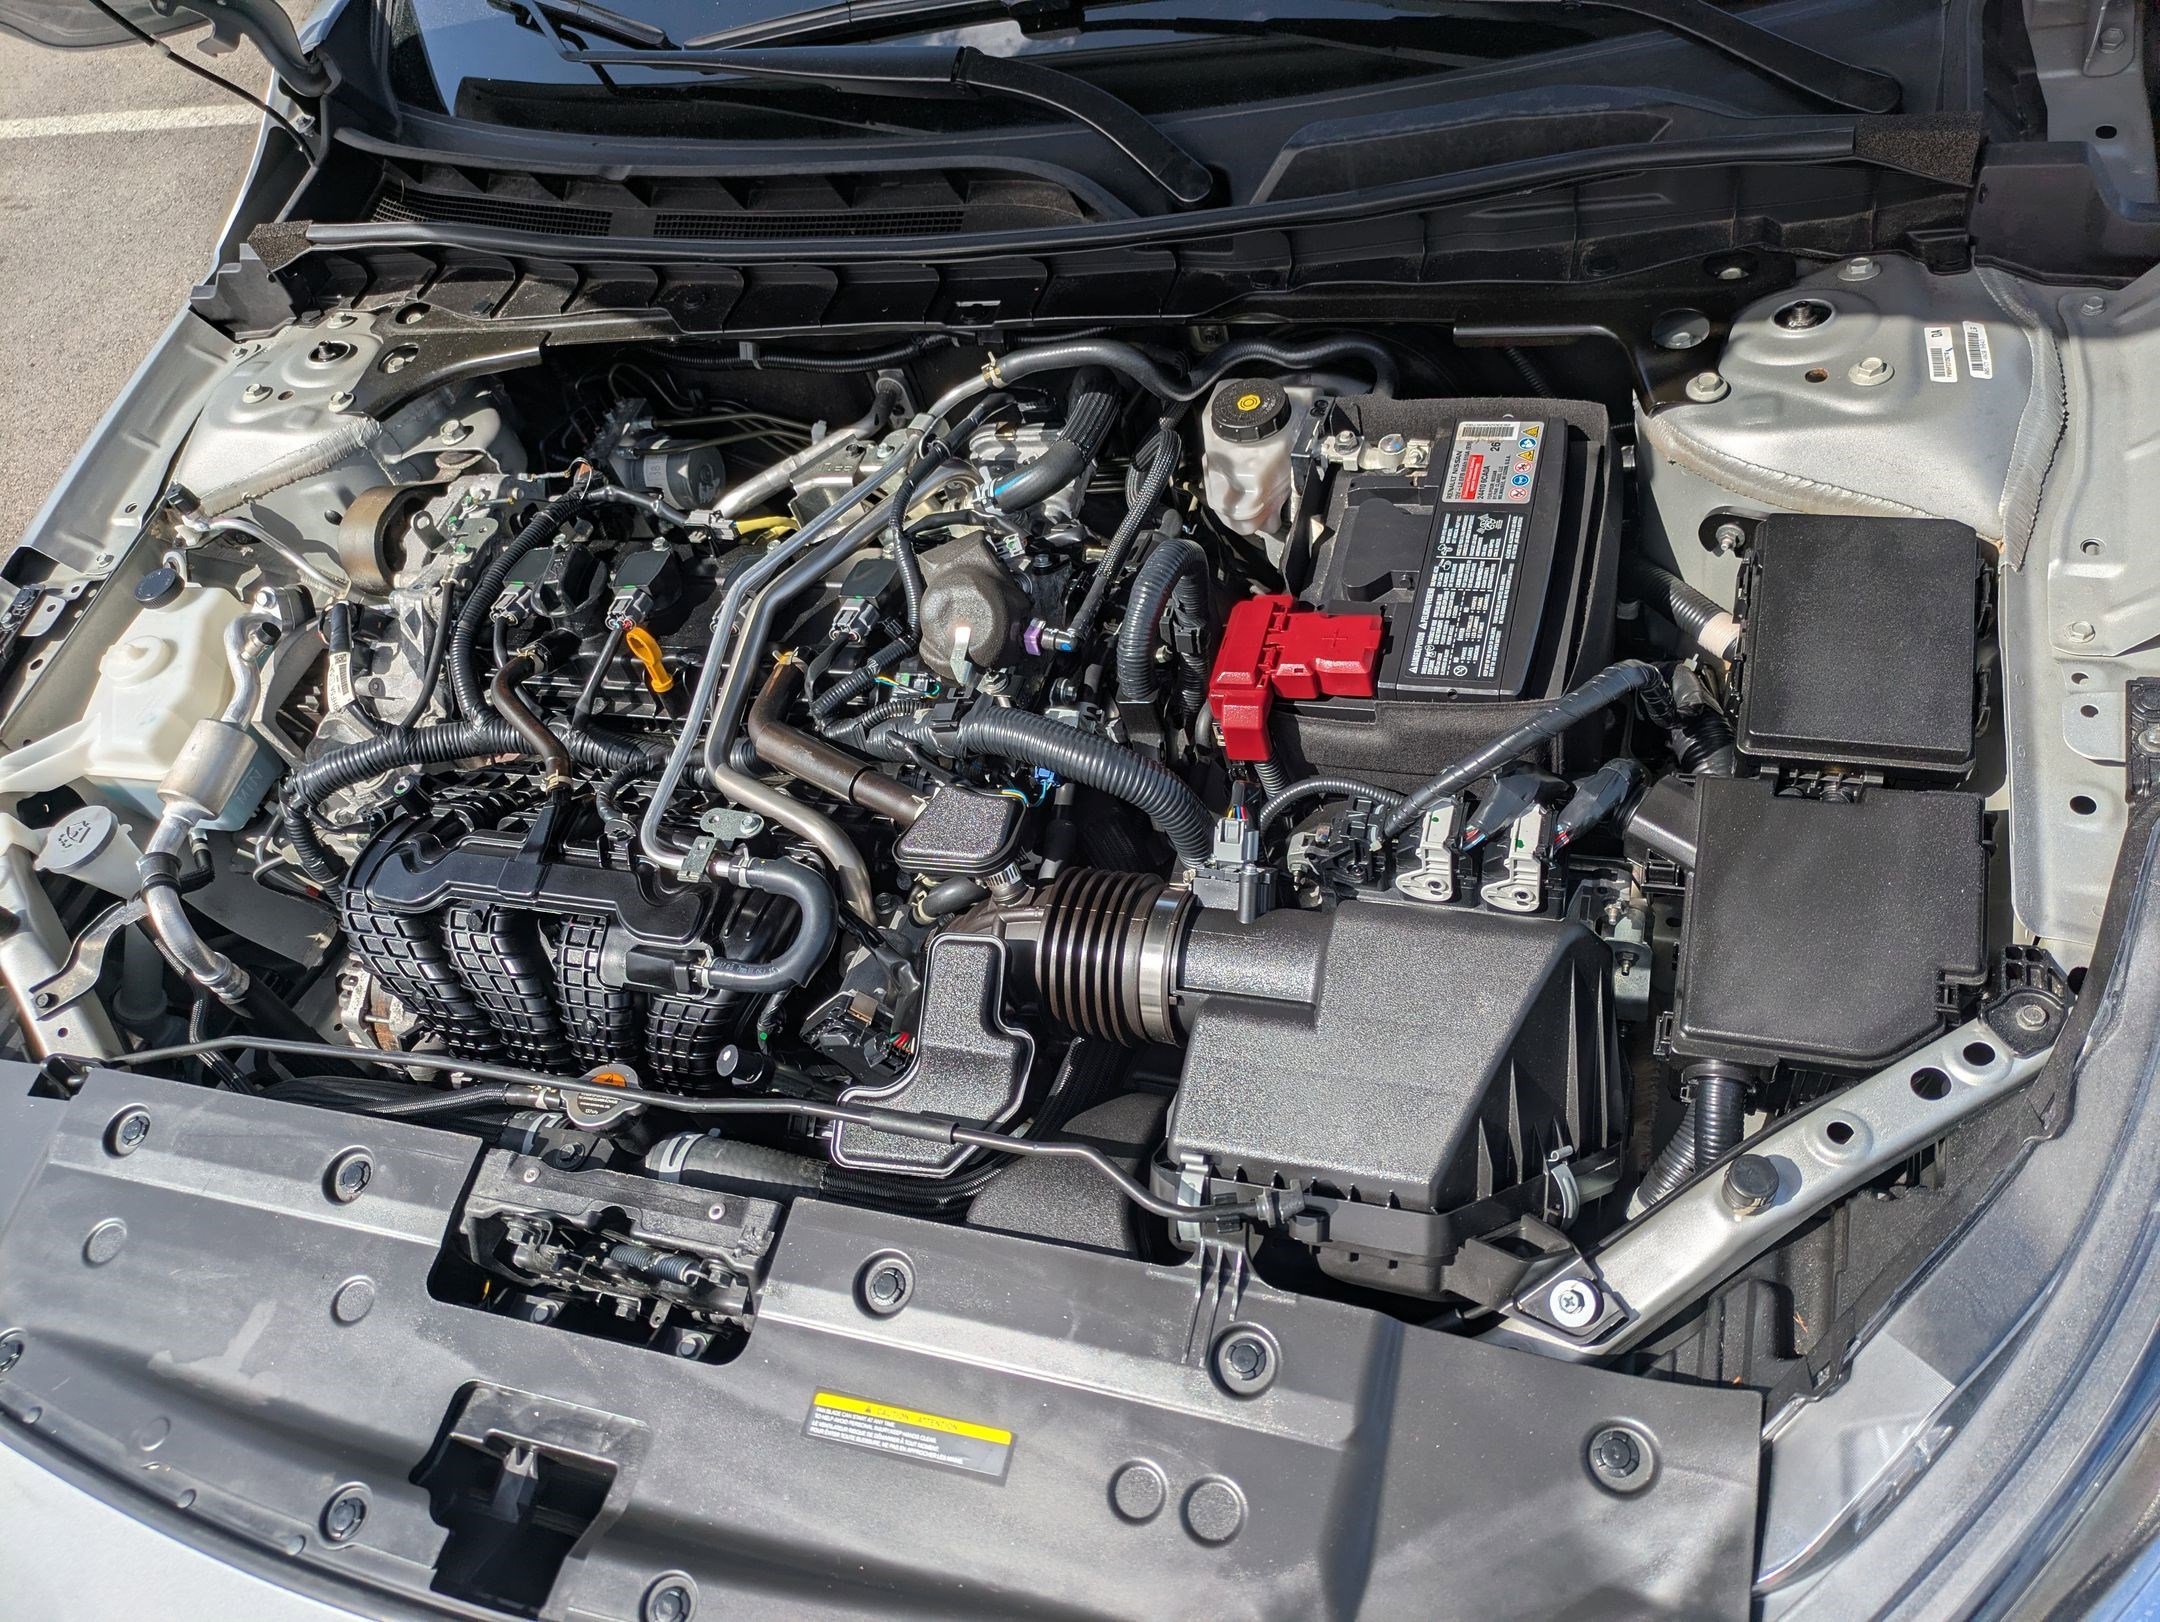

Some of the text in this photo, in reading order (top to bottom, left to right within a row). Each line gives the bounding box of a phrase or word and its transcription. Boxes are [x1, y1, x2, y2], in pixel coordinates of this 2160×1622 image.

[1489, 441, 1501, 451] 26
[1445, 450, 1462, 499] RENAULT NISSAN
[1476, 483, 1486, 499] 24410
